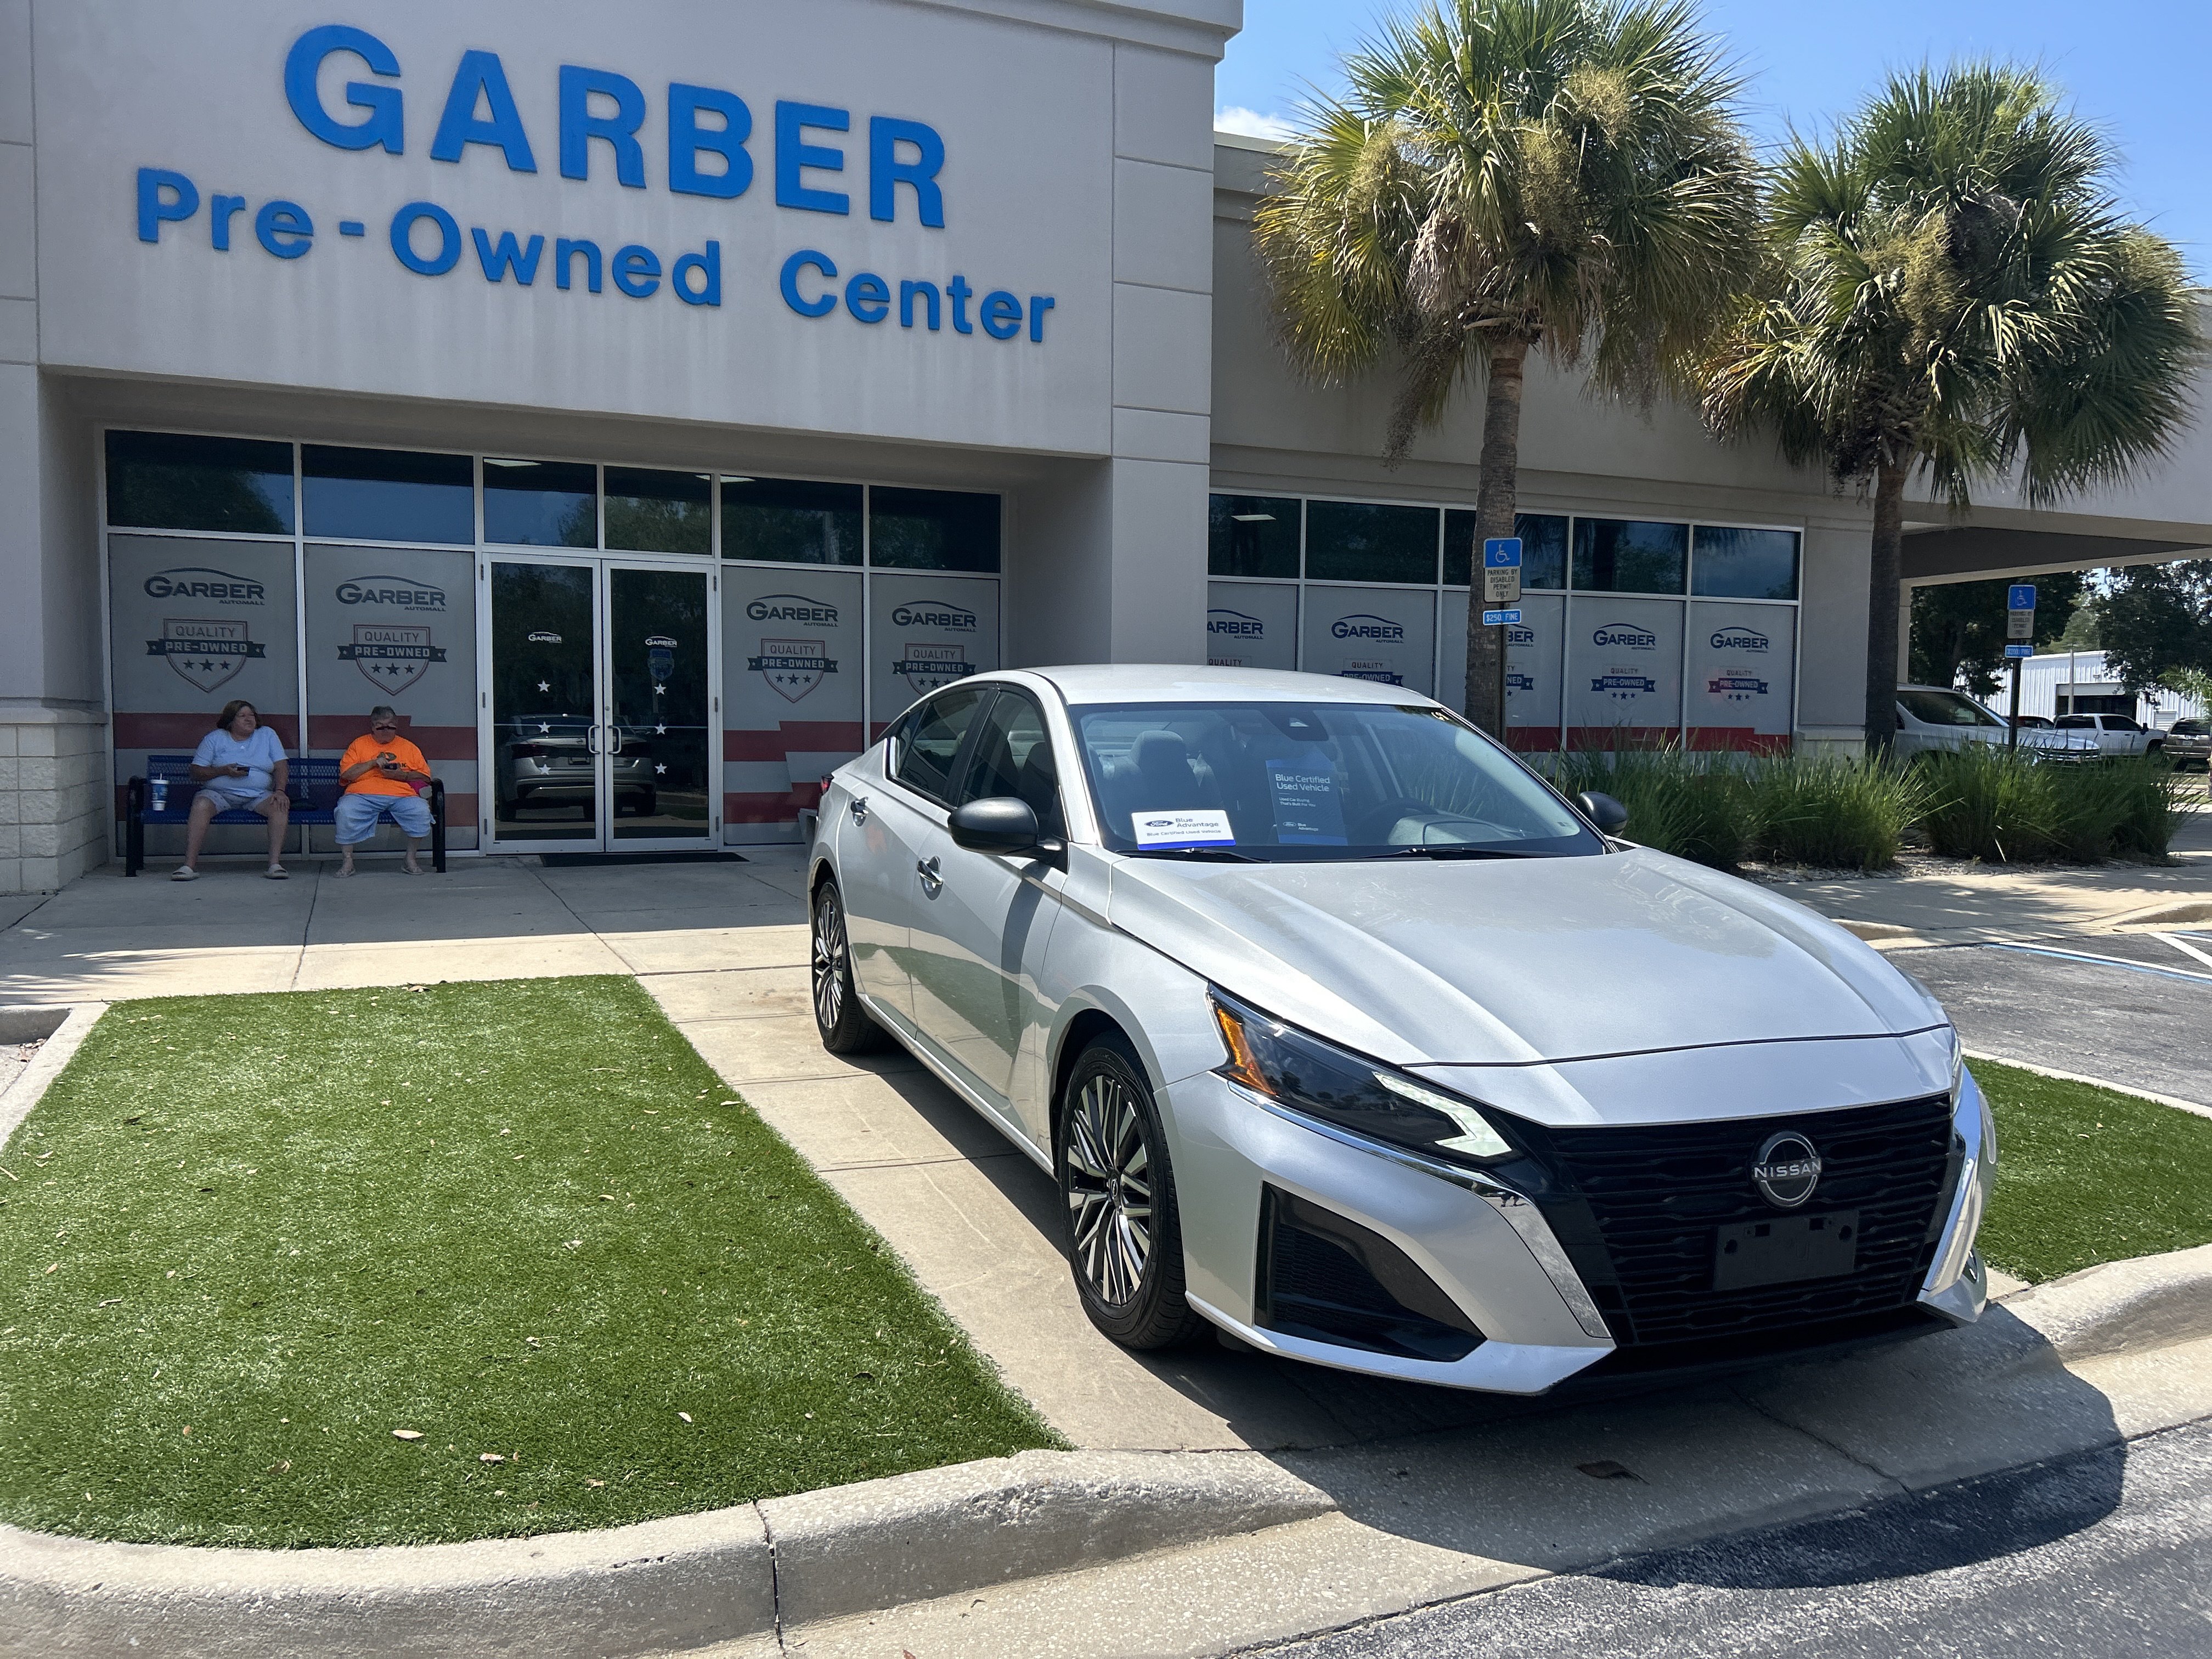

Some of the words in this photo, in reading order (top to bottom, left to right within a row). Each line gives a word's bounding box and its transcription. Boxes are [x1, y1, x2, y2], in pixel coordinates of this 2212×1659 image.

[284, 23, 946, 230] GARBER
[137, 167, 722, 307] Pre-Owned
[779, 249, 1056, 344] Center
[143, 575, 265, 600] GARBER
[336, 583, 447, 606] GARBER
[746, 601, 839, 622] GARBER
[891, 607, 977, 628] GARBER
[1505, 613, 1518, 621] FINE
[175, 625, 236, 638] QUALITY
[1207, 621, 1263, 635] ARBER
[1331, 621, 1403, 639] GARBER
[365, 631, 420, 642] QUALITY
[1593, 630, 1656, 646] GARBER
[1710, 633, 1769, 648] GARBER
[165, 641, 248, 653] PRE-OWNED
[354, 646, 431, 657] PRE-OWNED
[770, 645, 816, 655] QUALITY
[913, 649, 956, 659] QUALITY
[761, 658, 825, 668] PRE-OWNED
[906, 662, 964, 672] PRE-OWNED
[1275, 774, 1294, 782] Blue
[1295, 775, 1330, 783] Certified
[1277, 782, 1298, 790] Used
[1299, 783, 1329, 792] Vehicle
[1754, 1161, 1821, 1177] NISSAN
